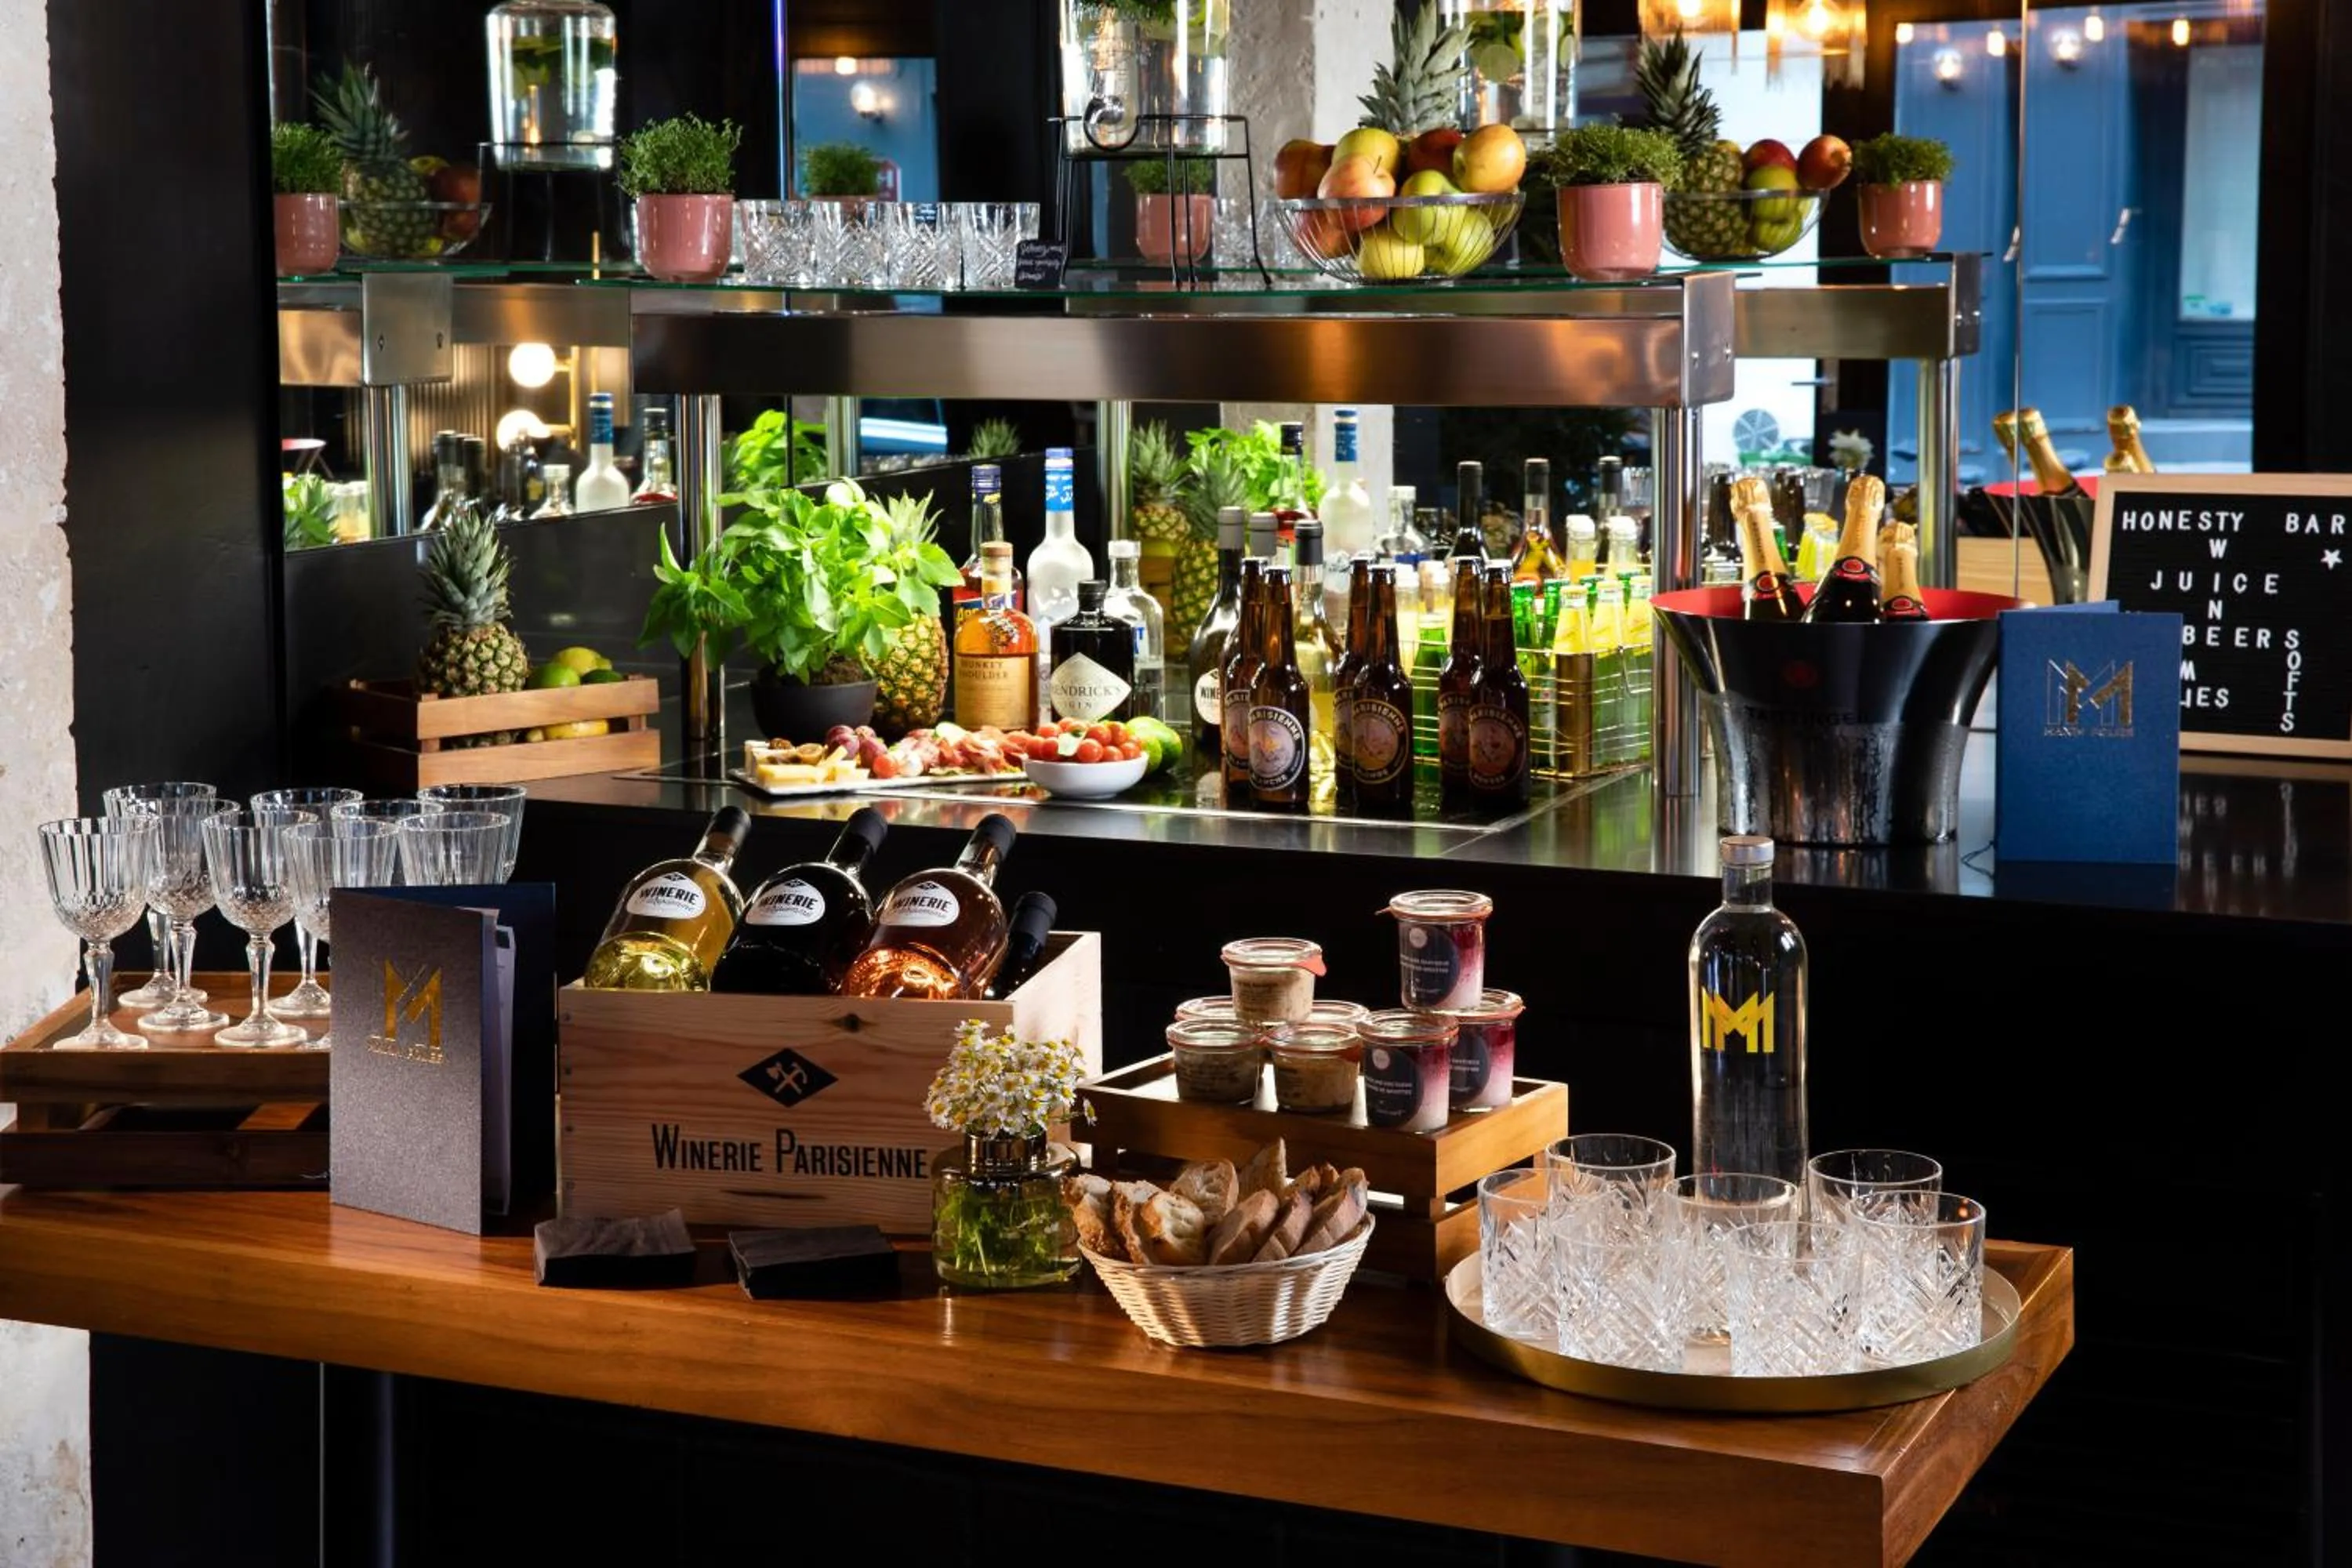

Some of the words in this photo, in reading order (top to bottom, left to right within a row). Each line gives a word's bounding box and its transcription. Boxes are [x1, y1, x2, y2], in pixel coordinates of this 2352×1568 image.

[2122, 510, 2245, 532] HONESTY
[2285, 513, 2347, 535] BAR
[2150, 570, 2280, 594] JUICE
[639, 886, 699, 905] WINERIE
[758, 893, 818, 910] WINERIE
[893, 896, 952, 912] WINERIE
[652, 1123, 763, 1172] WINERIE
[775, 1129, 928, 1178] PARISIENNE
